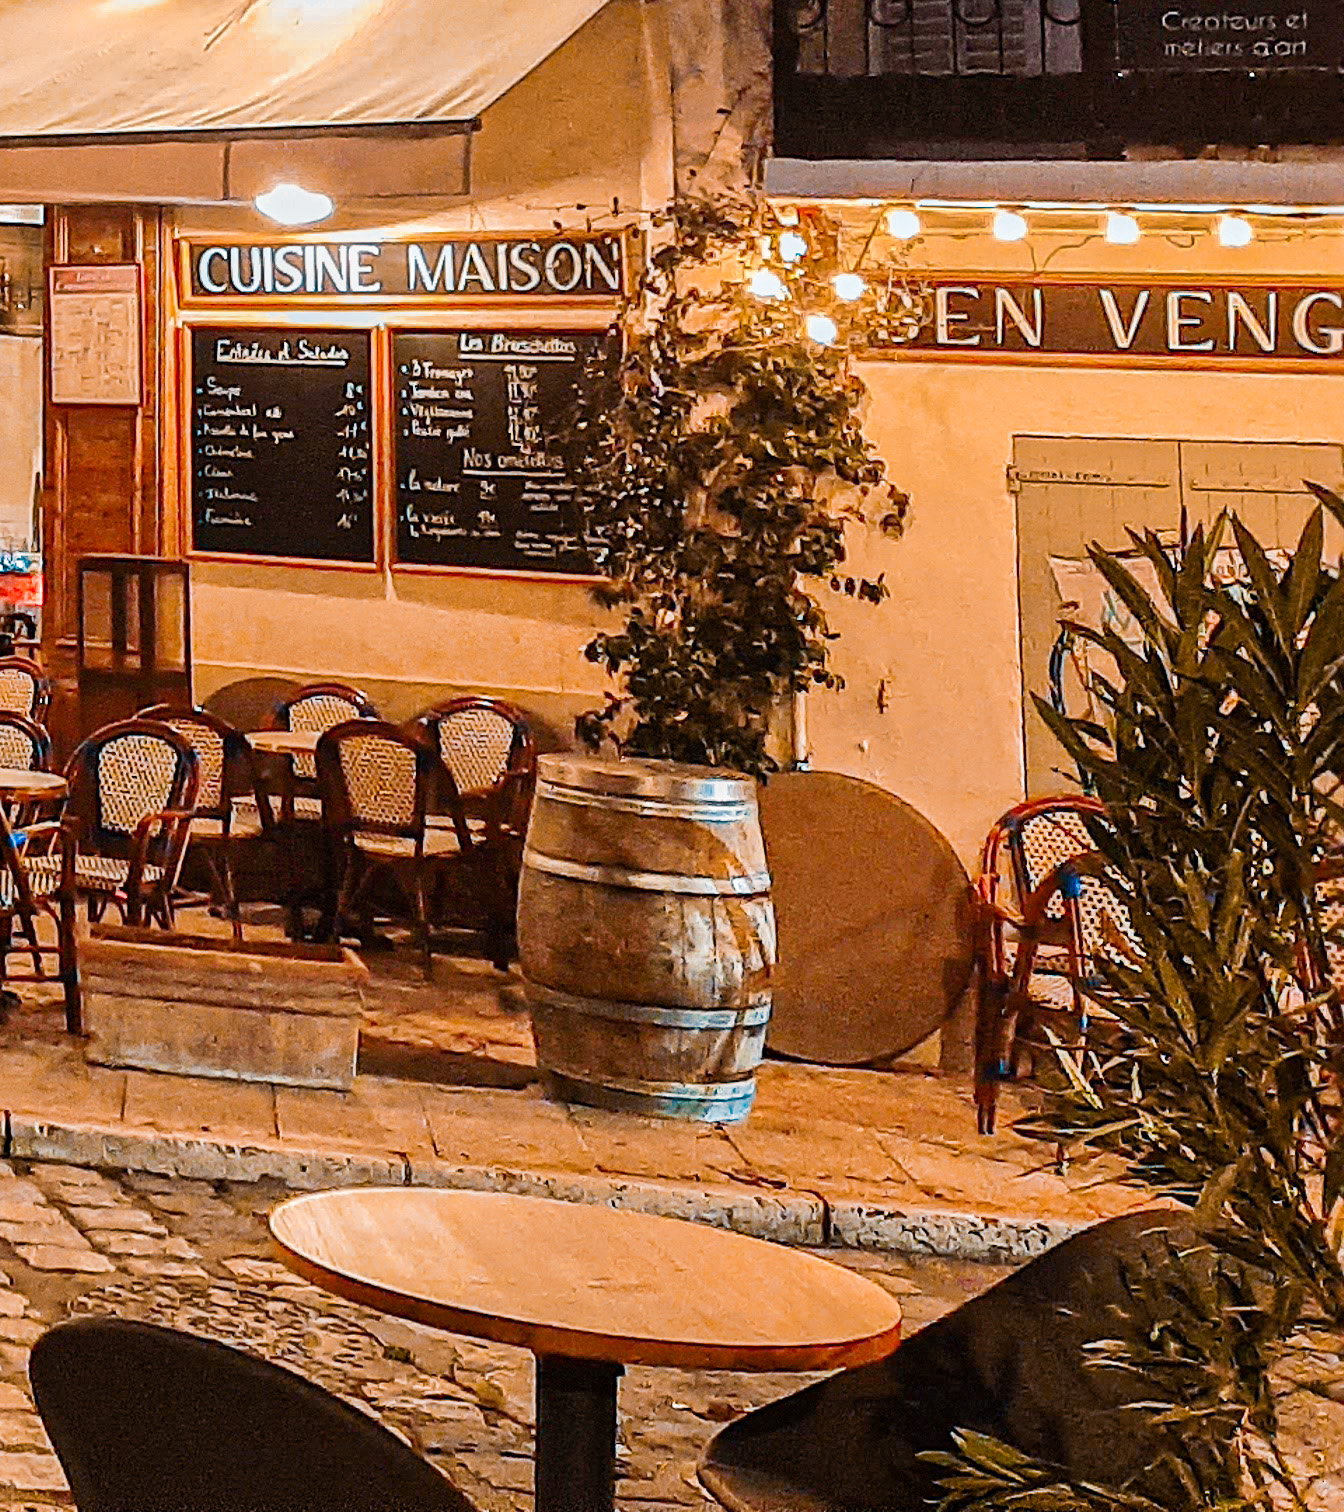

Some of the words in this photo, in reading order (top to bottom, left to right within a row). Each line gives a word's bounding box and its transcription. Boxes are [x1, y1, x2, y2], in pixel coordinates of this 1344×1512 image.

[1285, 11, 1308, 30] et
[197, 244, 382, 293] CUISINE
[407, 241, 621, 292] MAISON
[463, 447, 492, 469] Nos
